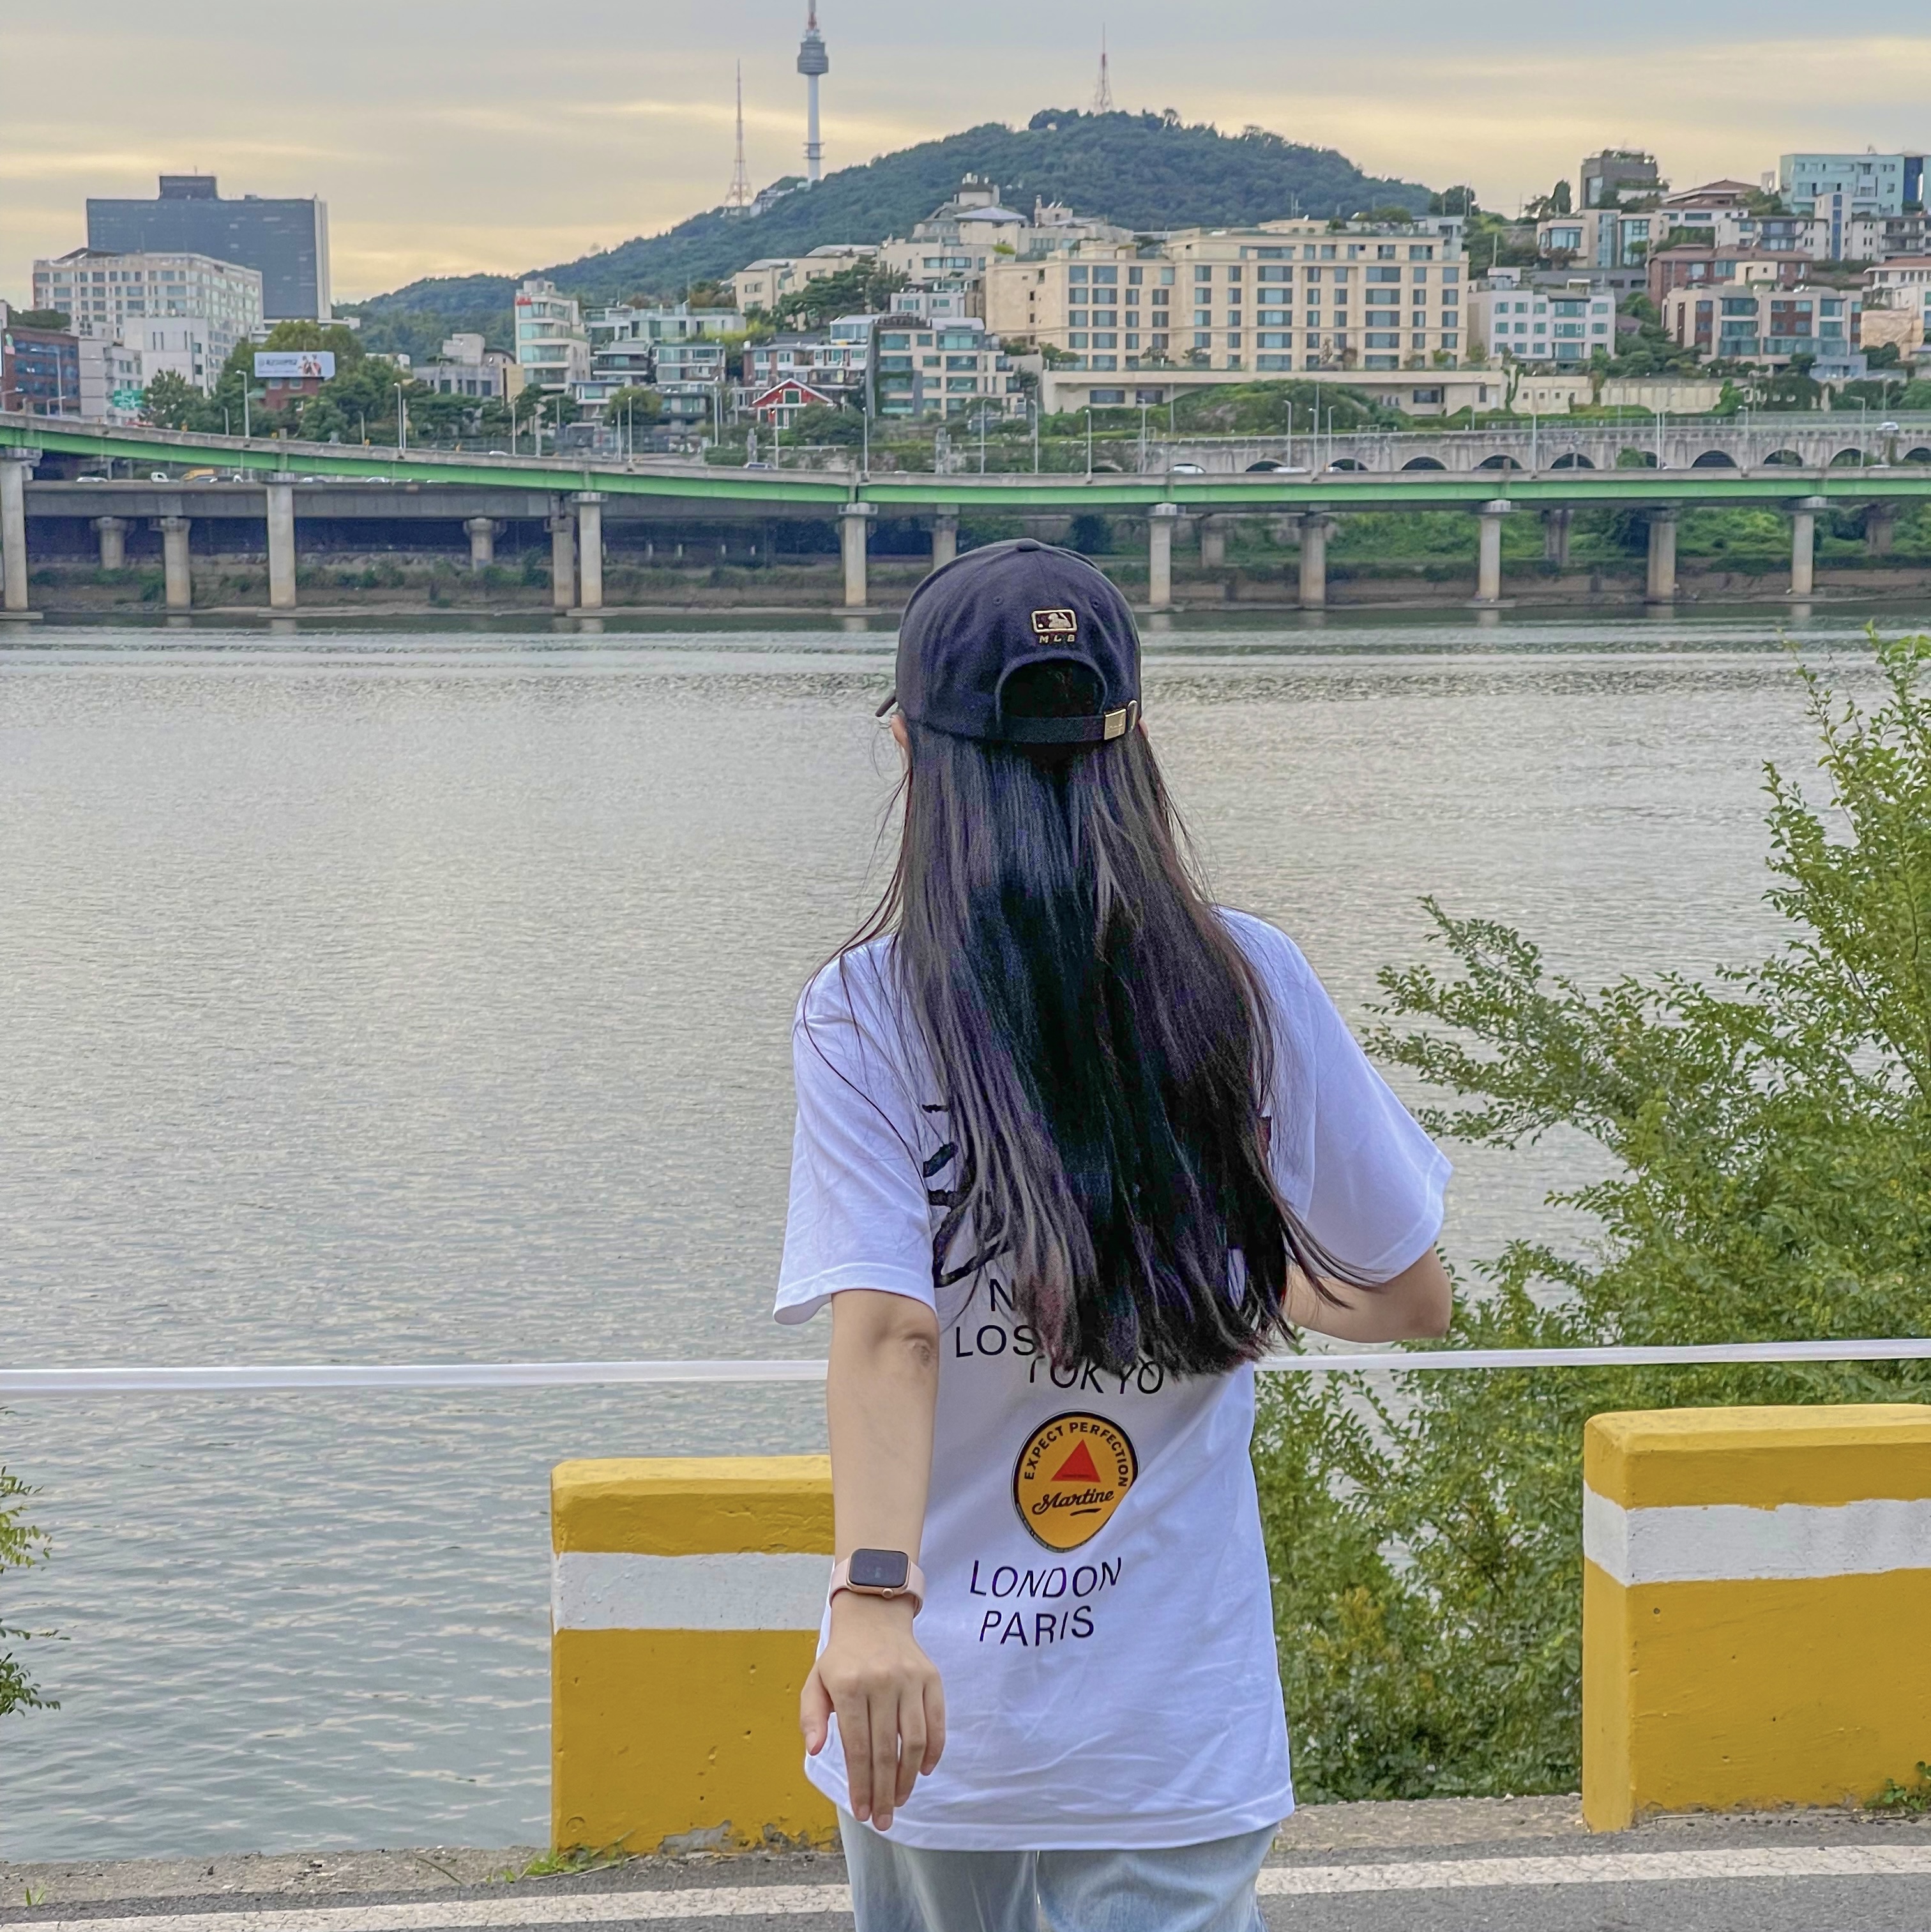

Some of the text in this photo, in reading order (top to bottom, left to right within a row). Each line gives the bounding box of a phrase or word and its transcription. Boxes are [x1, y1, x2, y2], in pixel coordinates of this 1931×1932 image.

[1040, 634, 1075, 643] MLB
[1024, 1422, 1129, 1487] EXPECT PERFECTION
[1032, 1488, 1114, 1516] Martine
[970, 1557, 1121, 1598] LONDON
[979, 1605, 1094, 1647] PARIS
